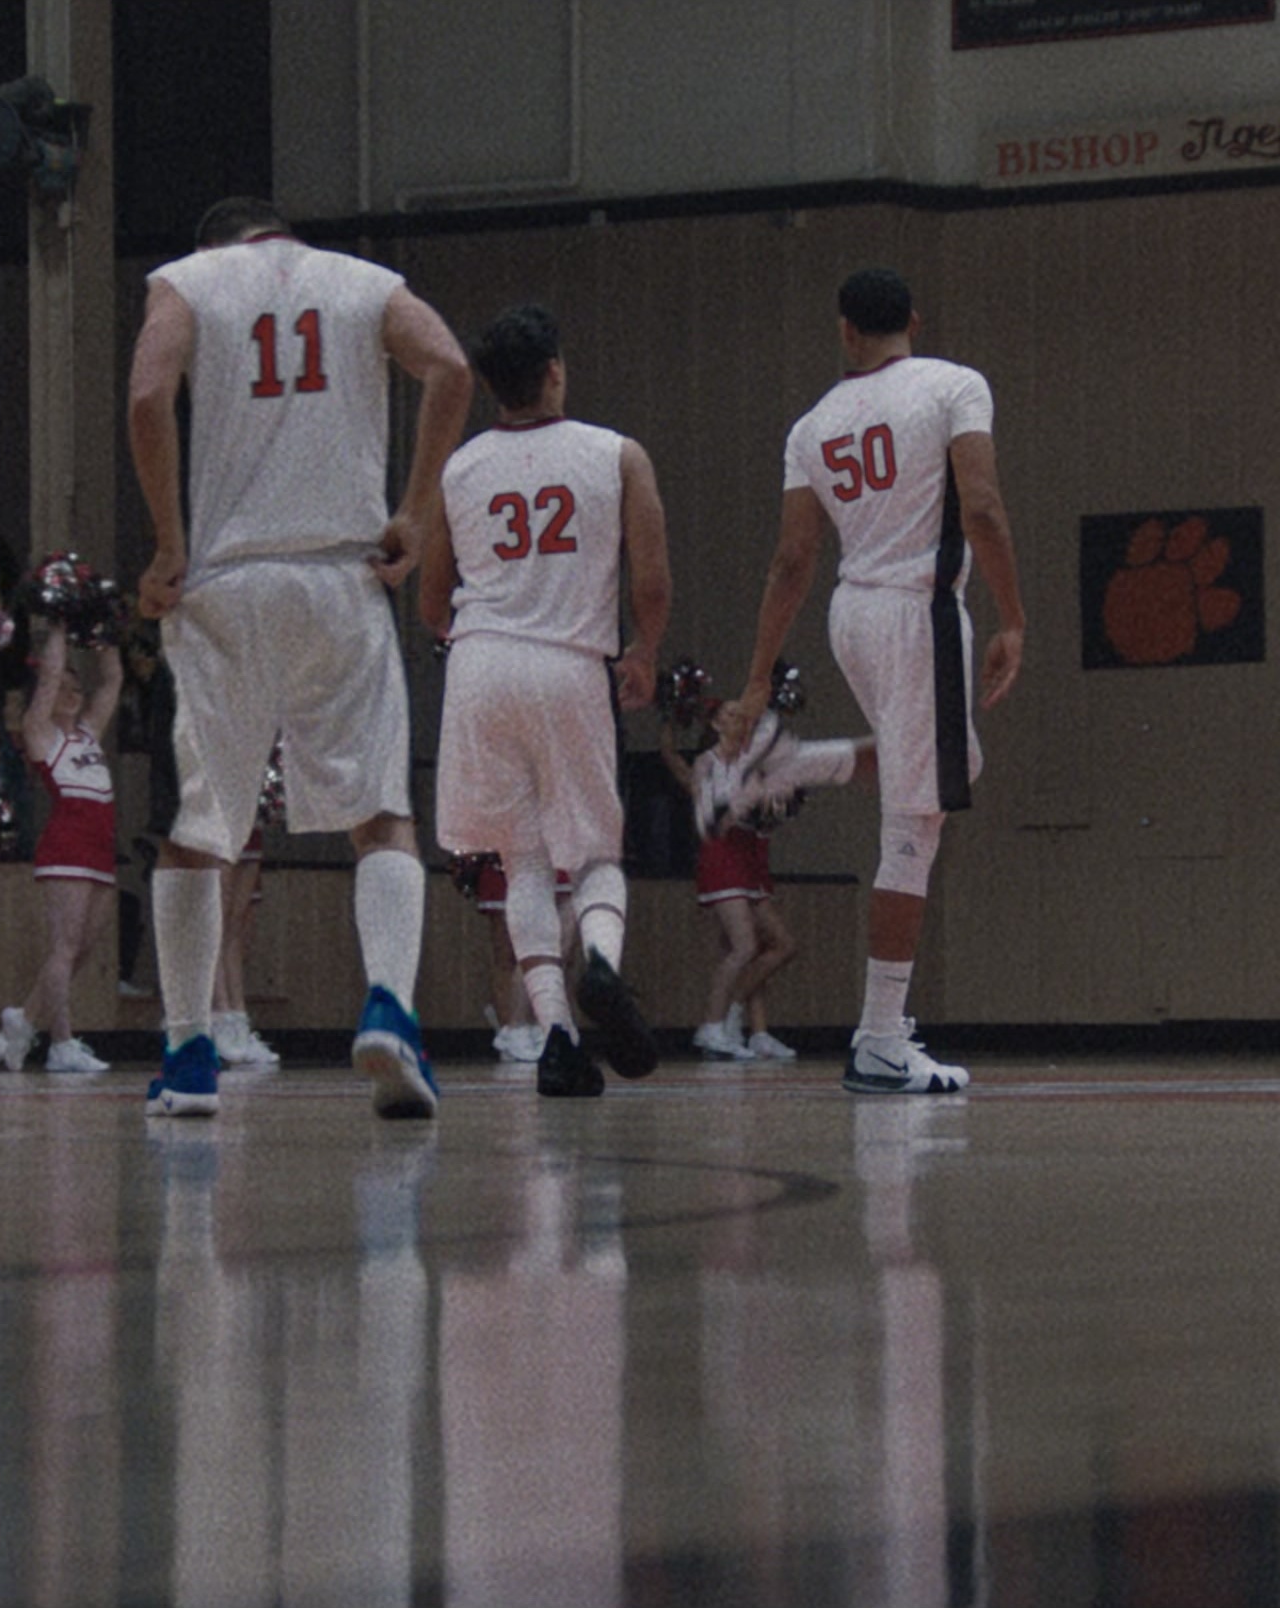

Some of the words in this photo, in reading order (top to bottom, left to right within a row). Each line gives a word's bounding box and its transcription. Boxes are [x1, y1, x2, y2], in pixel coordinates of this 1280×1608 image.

[996, 130, 1160, 177] BISHOP
[251, 308, 327, 398] 11
[821, 422, 898, 503] 50
[488, 484, 578, 562] 32
